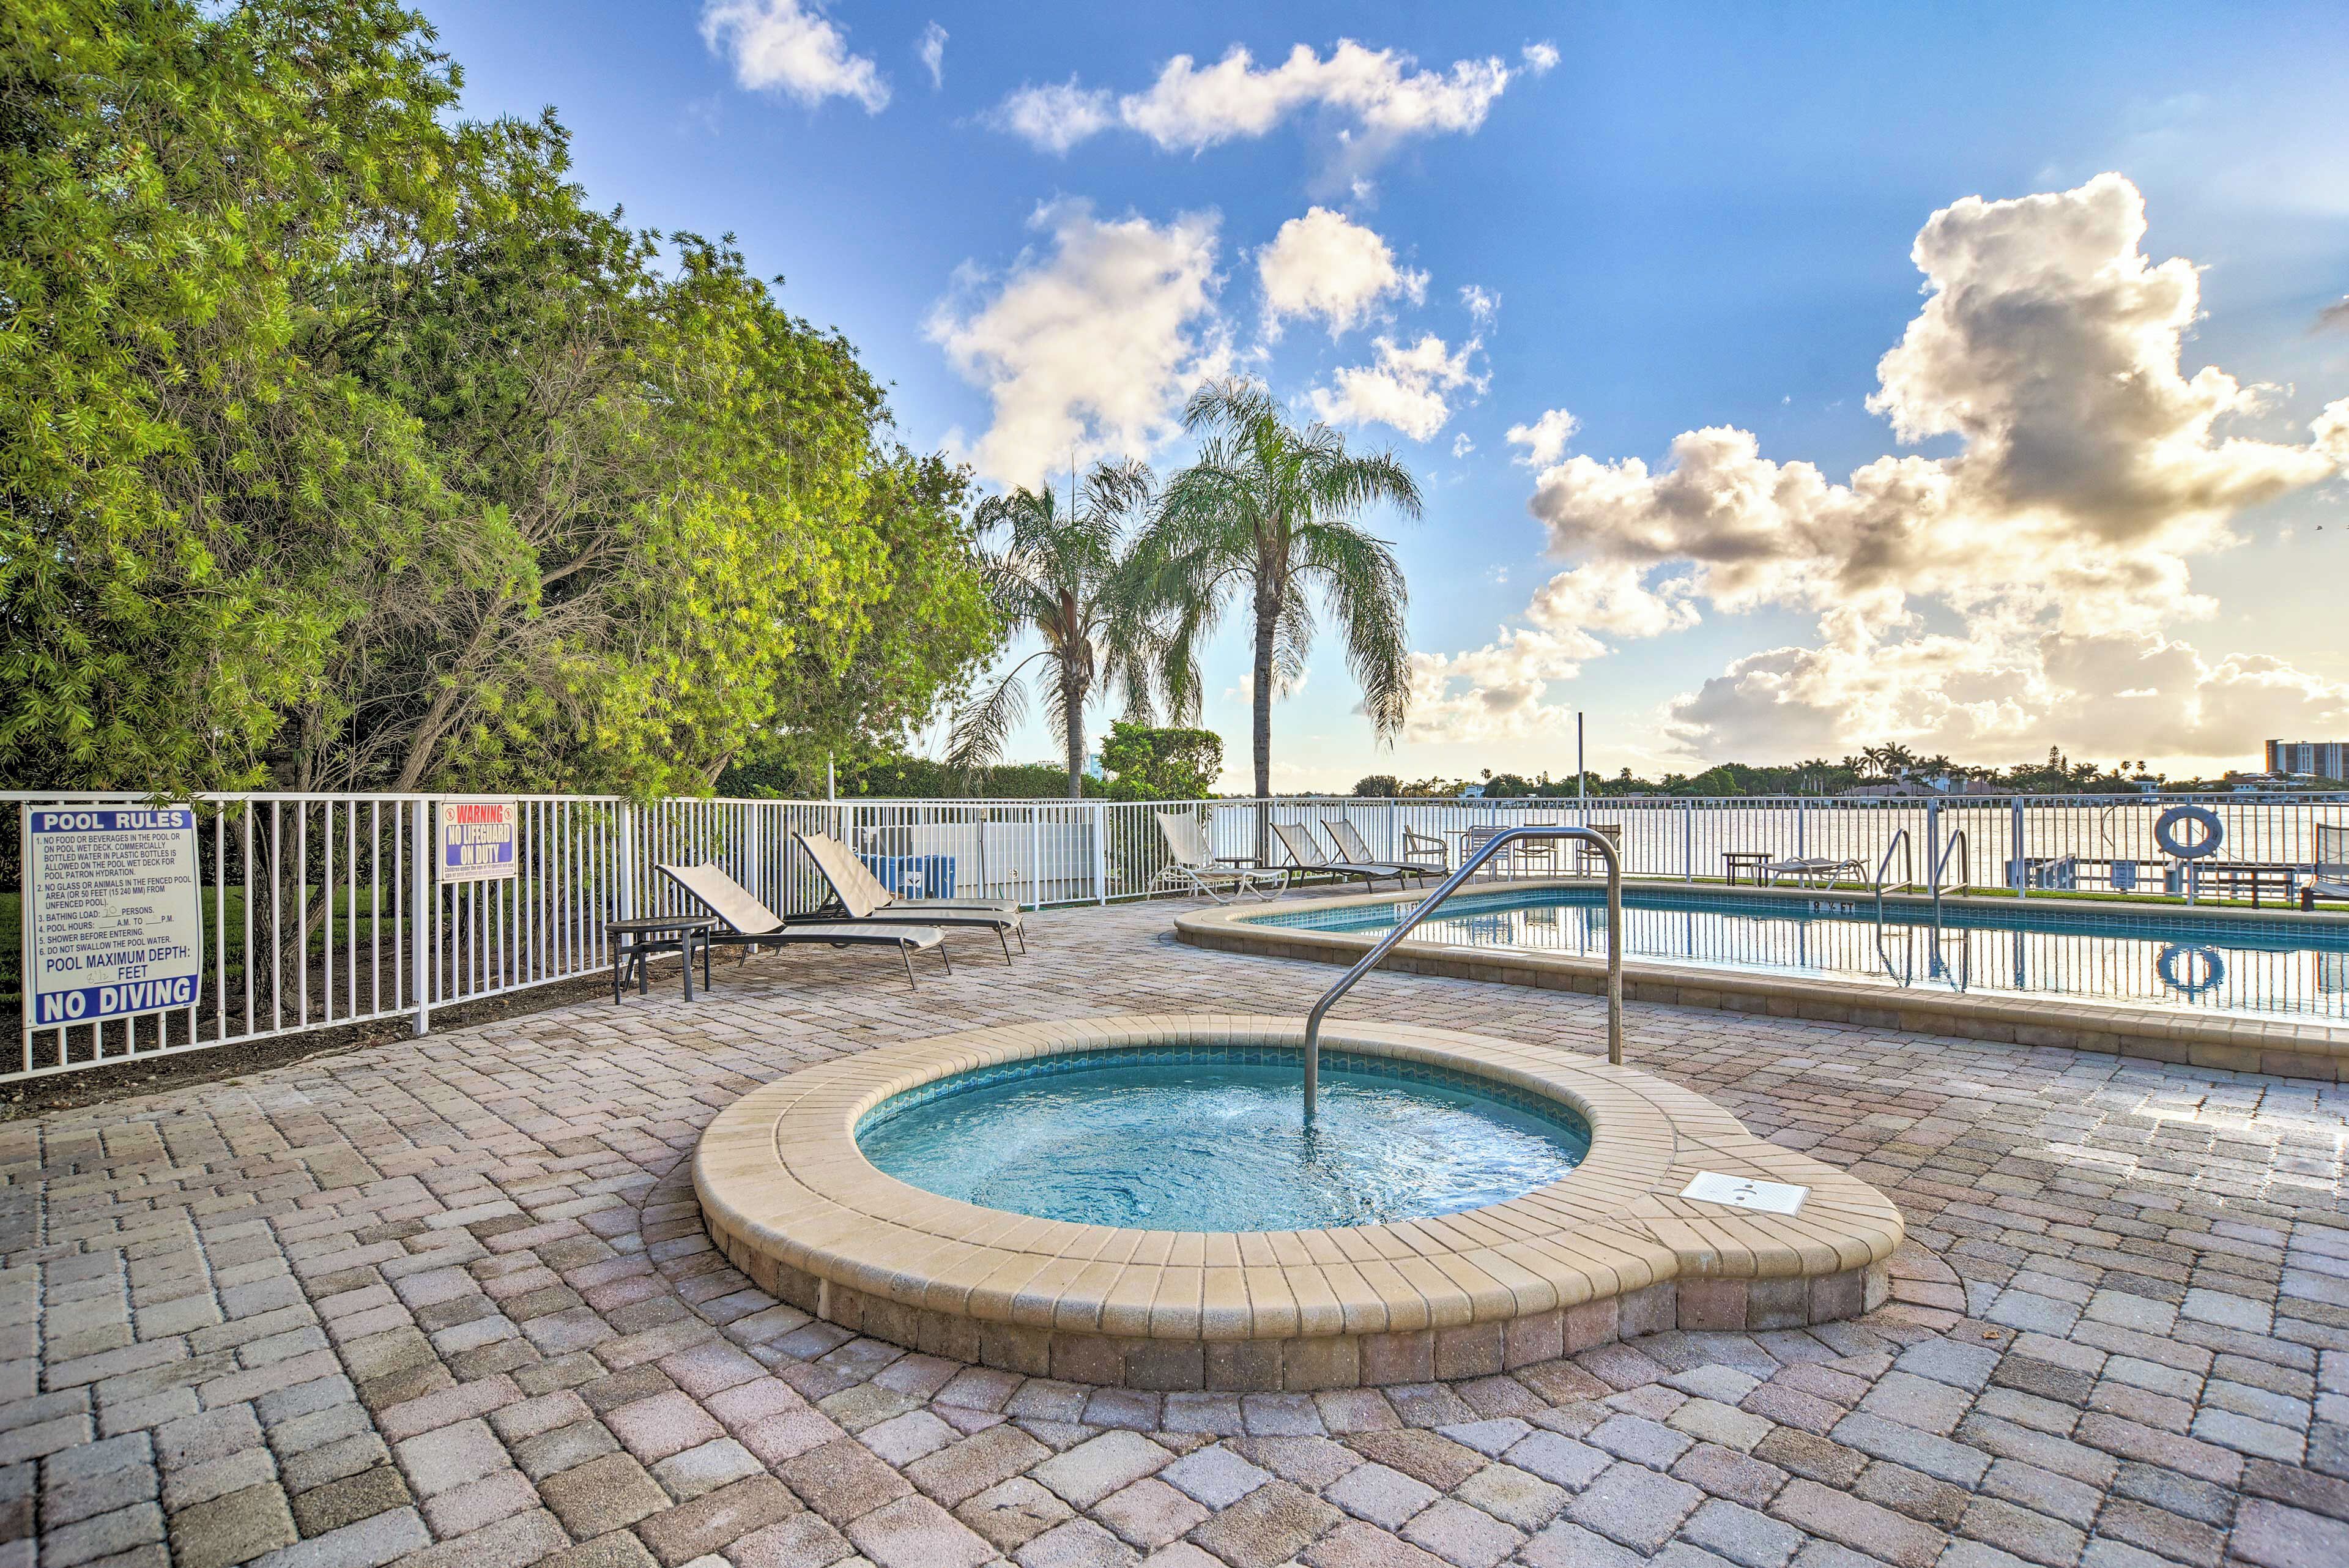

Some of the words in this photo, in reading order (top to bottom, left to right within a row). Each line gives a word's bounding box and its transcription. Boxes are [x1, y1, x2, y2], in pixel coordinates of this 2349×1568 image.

[44, 813, 103, 830] POOL
[116, 812, 183, 828] RULES
[457, 804, 503, 823] WARNING
[448, 825, 461, 845] NO
[464, 824, 510, 844] LIFEGUARD
[461, 845, 473, 864] ON
[476, 844, 499, 863] DUTY
[45, 862, 78, 871] ALLOWED
[67, 890, 79, 899] (OR
[46, 901, 83, 909] UNFENCED
[1397, 905, 1401, 920] 8
[46, 912, 77, 921] BATHING
[122, 907, 154, 915] PERSONS.
[47, 924, 66, 932] POOL
[69, 922, 94, 931] HOURS:
[48, 934, 78, 943] SHOWER
[80, 931, 108, 940] BEFORE
[110, 929, 144, 938] ENTERING.
[76, 942, 111, 951] SWALLOW
[147, 936, 171, 945] WATER.
[47, 957, 83, 972] POOL
[87, 950, 145, 968] MAXIMUM
[149, 945, 190, 961] DEPTH:
[119, 965, 147, 979] FEET
[44, 991, 86, 1021] NO
[100, 978, 190, 1014] DIVING
